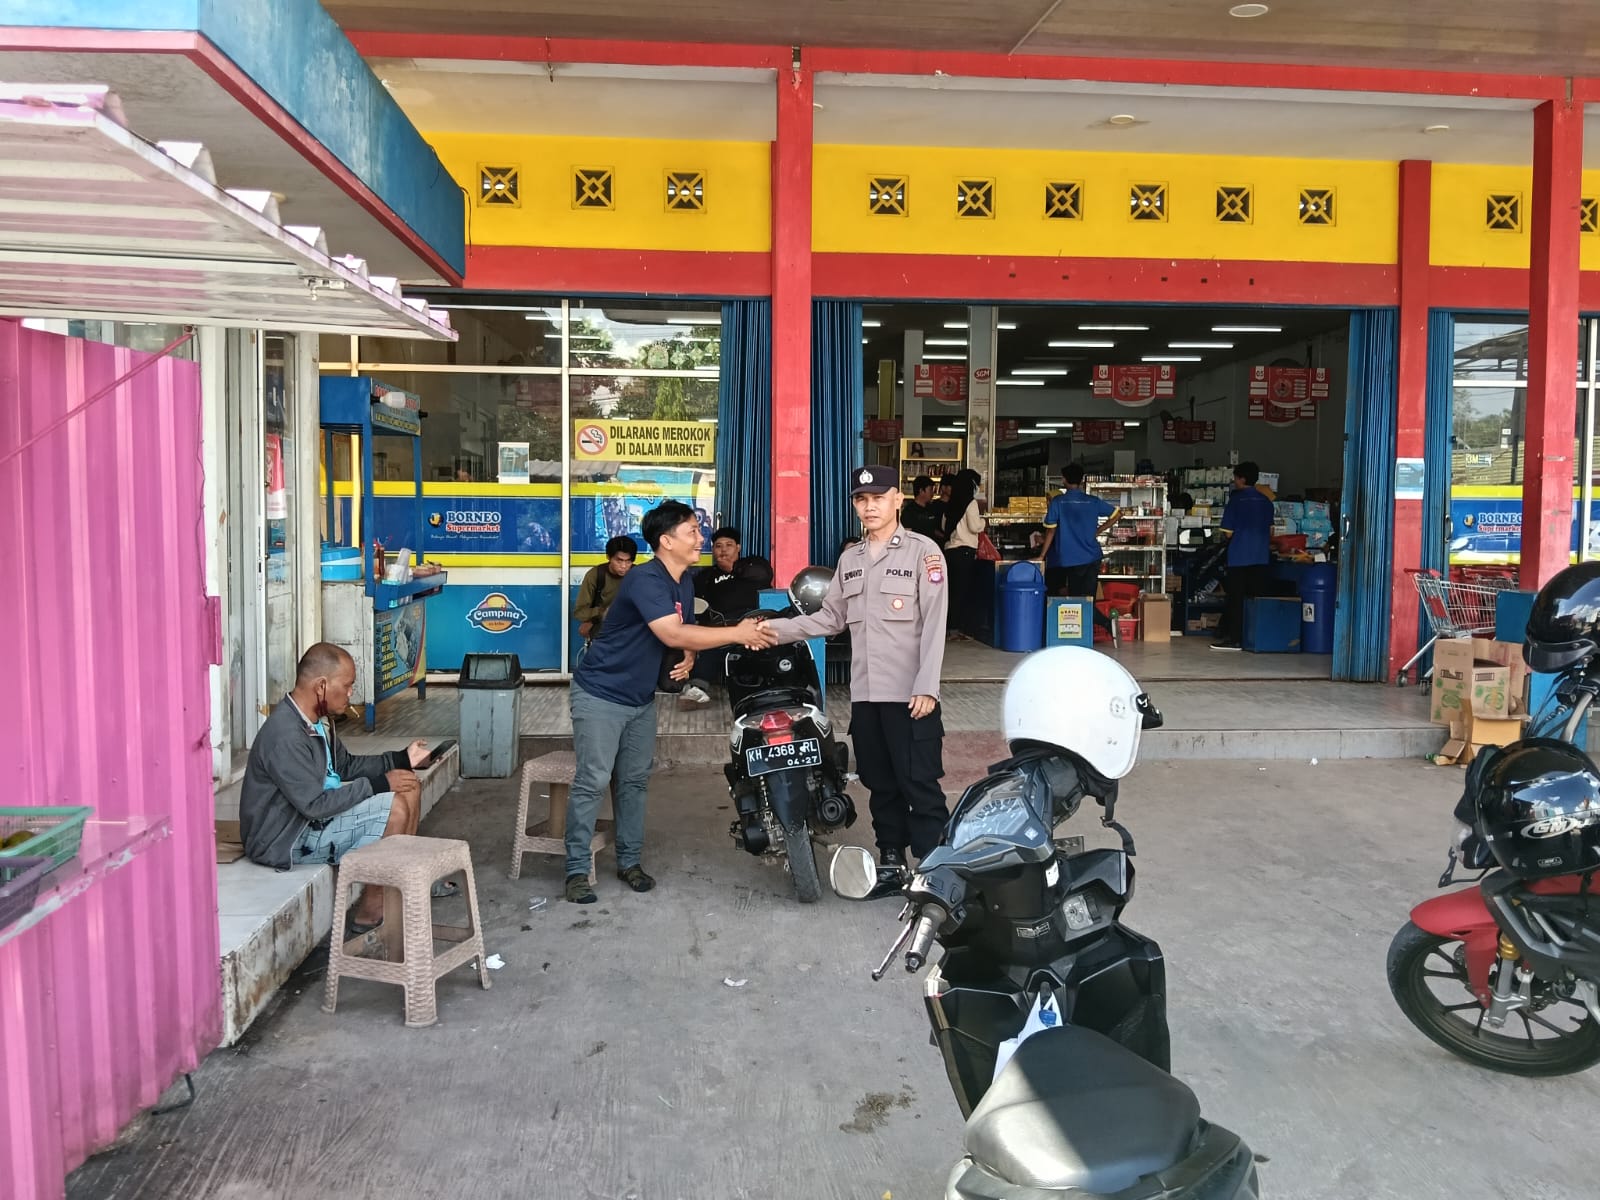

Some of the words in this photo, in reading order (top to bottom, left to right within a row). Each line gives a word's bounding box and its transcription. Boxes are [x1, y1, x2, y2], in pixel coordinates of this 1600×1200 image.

[610, 426, 659, 439] DILARANG
[662, 427, 711, 441] MEROKOK
[616, 443, 625, 456] DI
[628, 443, 661, 456] DALAM
[664, 444, 705, 457] MARKET
[447, 511, 501, 523] BORNEO
[446, 523, 500, 533] Supermarket
[1479, 525, 1521, 533] Supermarke
[886, 568, 912, 577] POLRI
[473, 610, 520, 620] Campina
[748, 748, 762, 762] KH
[768, 744, 796, 758] 4368
[801, 741, 817, 753] RL
[1533, 819, 1567, 834] GM
